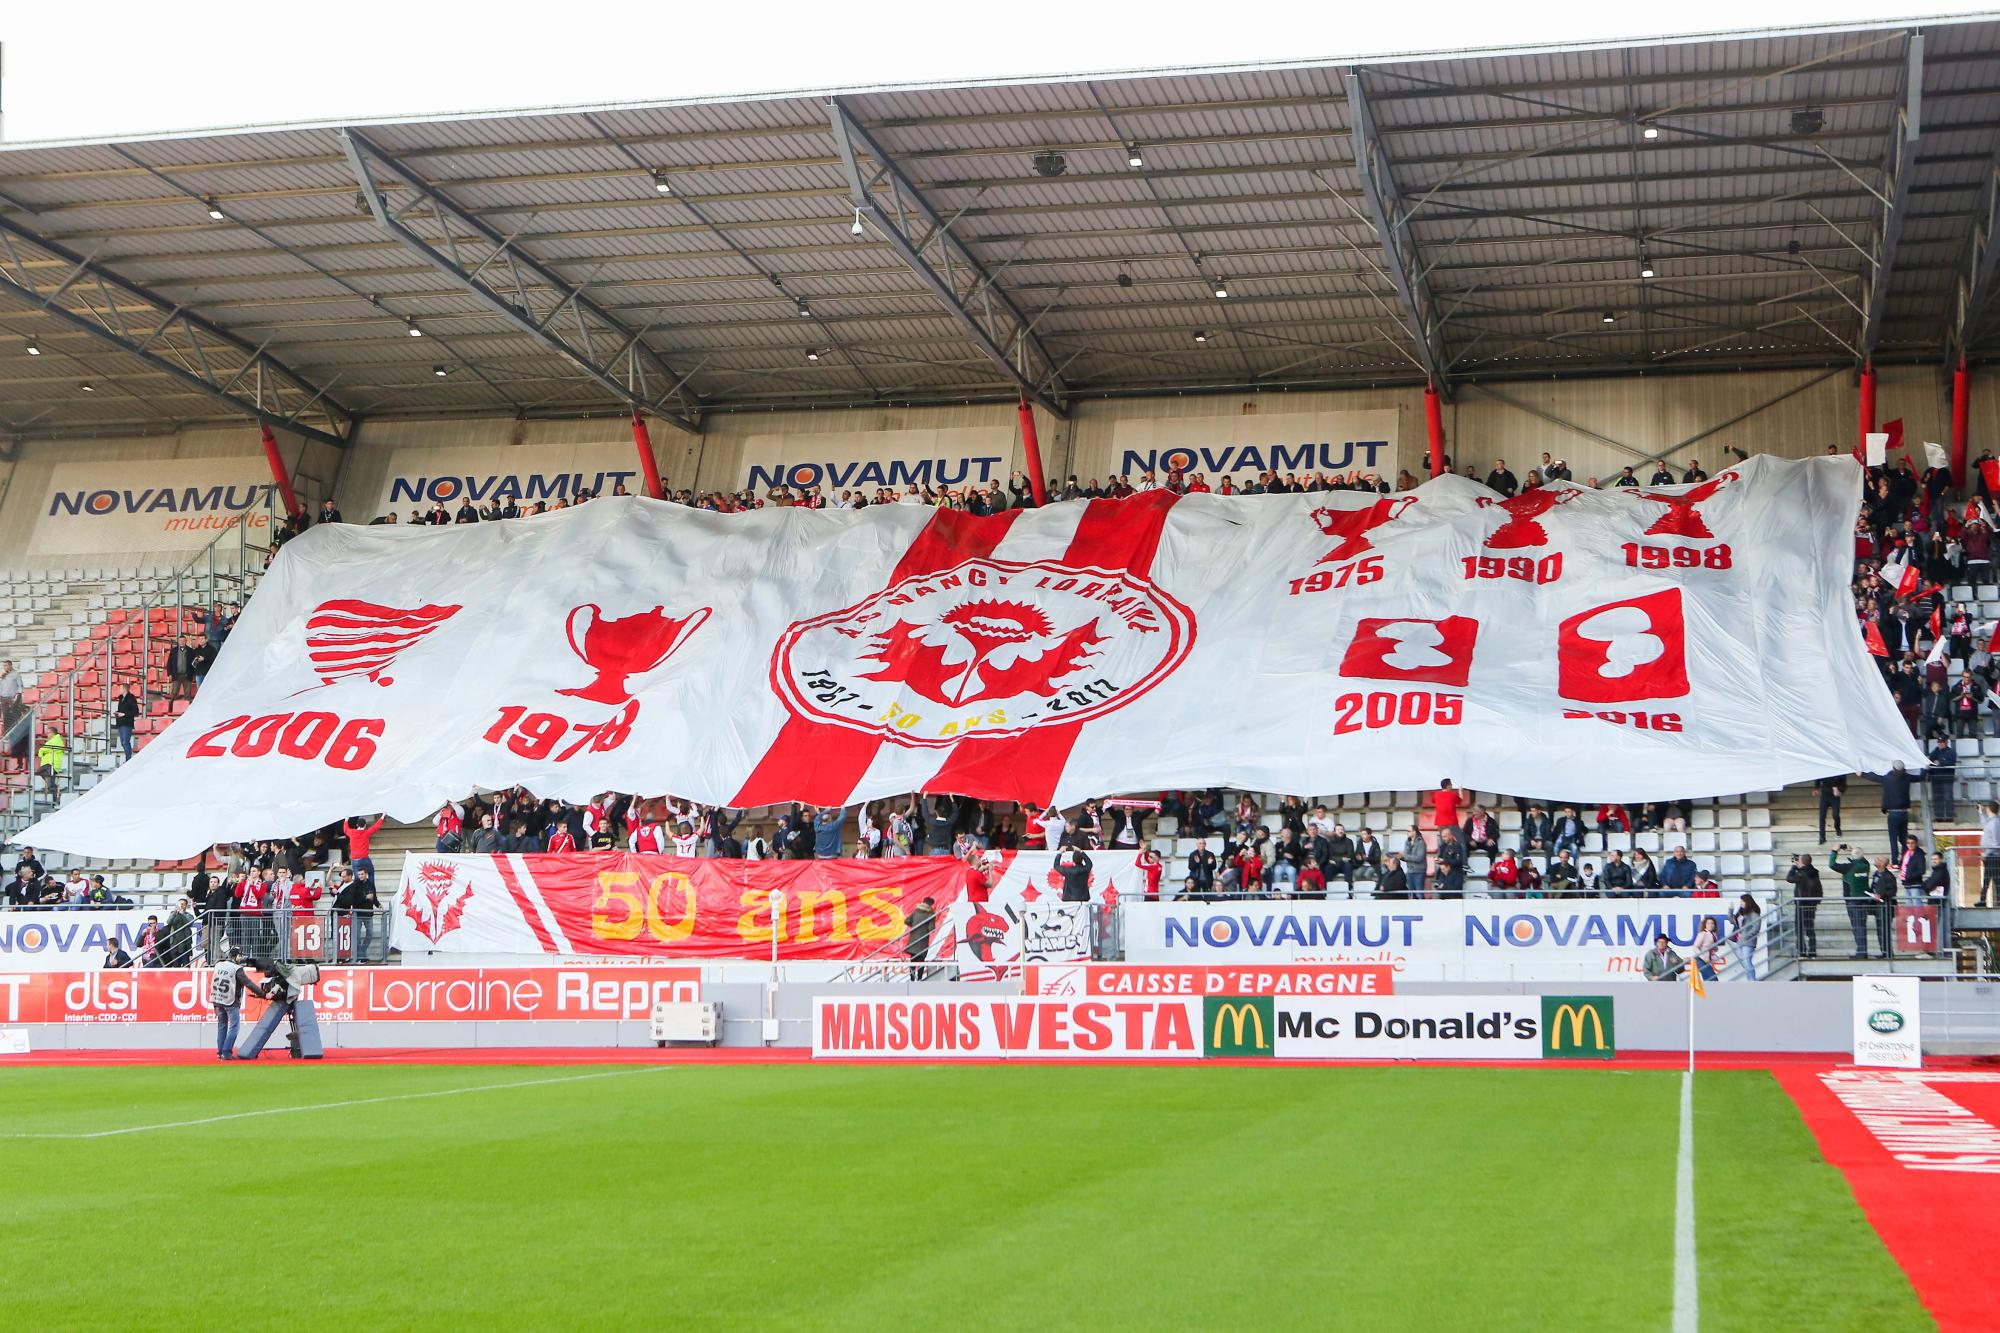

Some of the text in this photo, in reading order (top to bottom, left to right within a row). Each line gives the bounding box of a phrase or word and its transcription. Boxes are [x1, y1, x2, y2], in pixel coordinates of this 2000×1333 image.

[748, 457, 1003, 491] NOVAMUT
[1122, 441, 1389, 476] NOVAMUT
[49, 484, 278, 517] NOVAMUT
[389, 471, 637, 503] NOVAMUT
[1460, 551, 1563, 586] 1990
[1621, 542, 1733, 571] 1998
[1288, 554, 1385, 596] 1975
[939, 708, 1006, 737] ANS
[1046, 678, 1119, 712] 2017
[1333, 691, 1465, 736] 2005
[186, 711, 386, 771] 2006
[483, 698, 639, 763] 1978
[592, 870, 908, 943] 50 ans
[0, 922, 204, 953] OVAM
[294, 924, 321, 951] 13
[338, 924, 351, 951] 13
[1164, 914, 1424, 948] NOVAMUT
[1465, 914, 1733, 947] NOVAMUT
[1906, 914, 1932, 944] 11
[65, 971, 139, 1011] dlsi
[368, 969, 699, 1020] Lorraine Repro
[1099, 973, 1377, 994] CAISSE D'EPARGNE
[821, 1002, 1196, 1051] MAISONS VESTA
[1278, 1011, 1538, 1040] Mc Donald's
